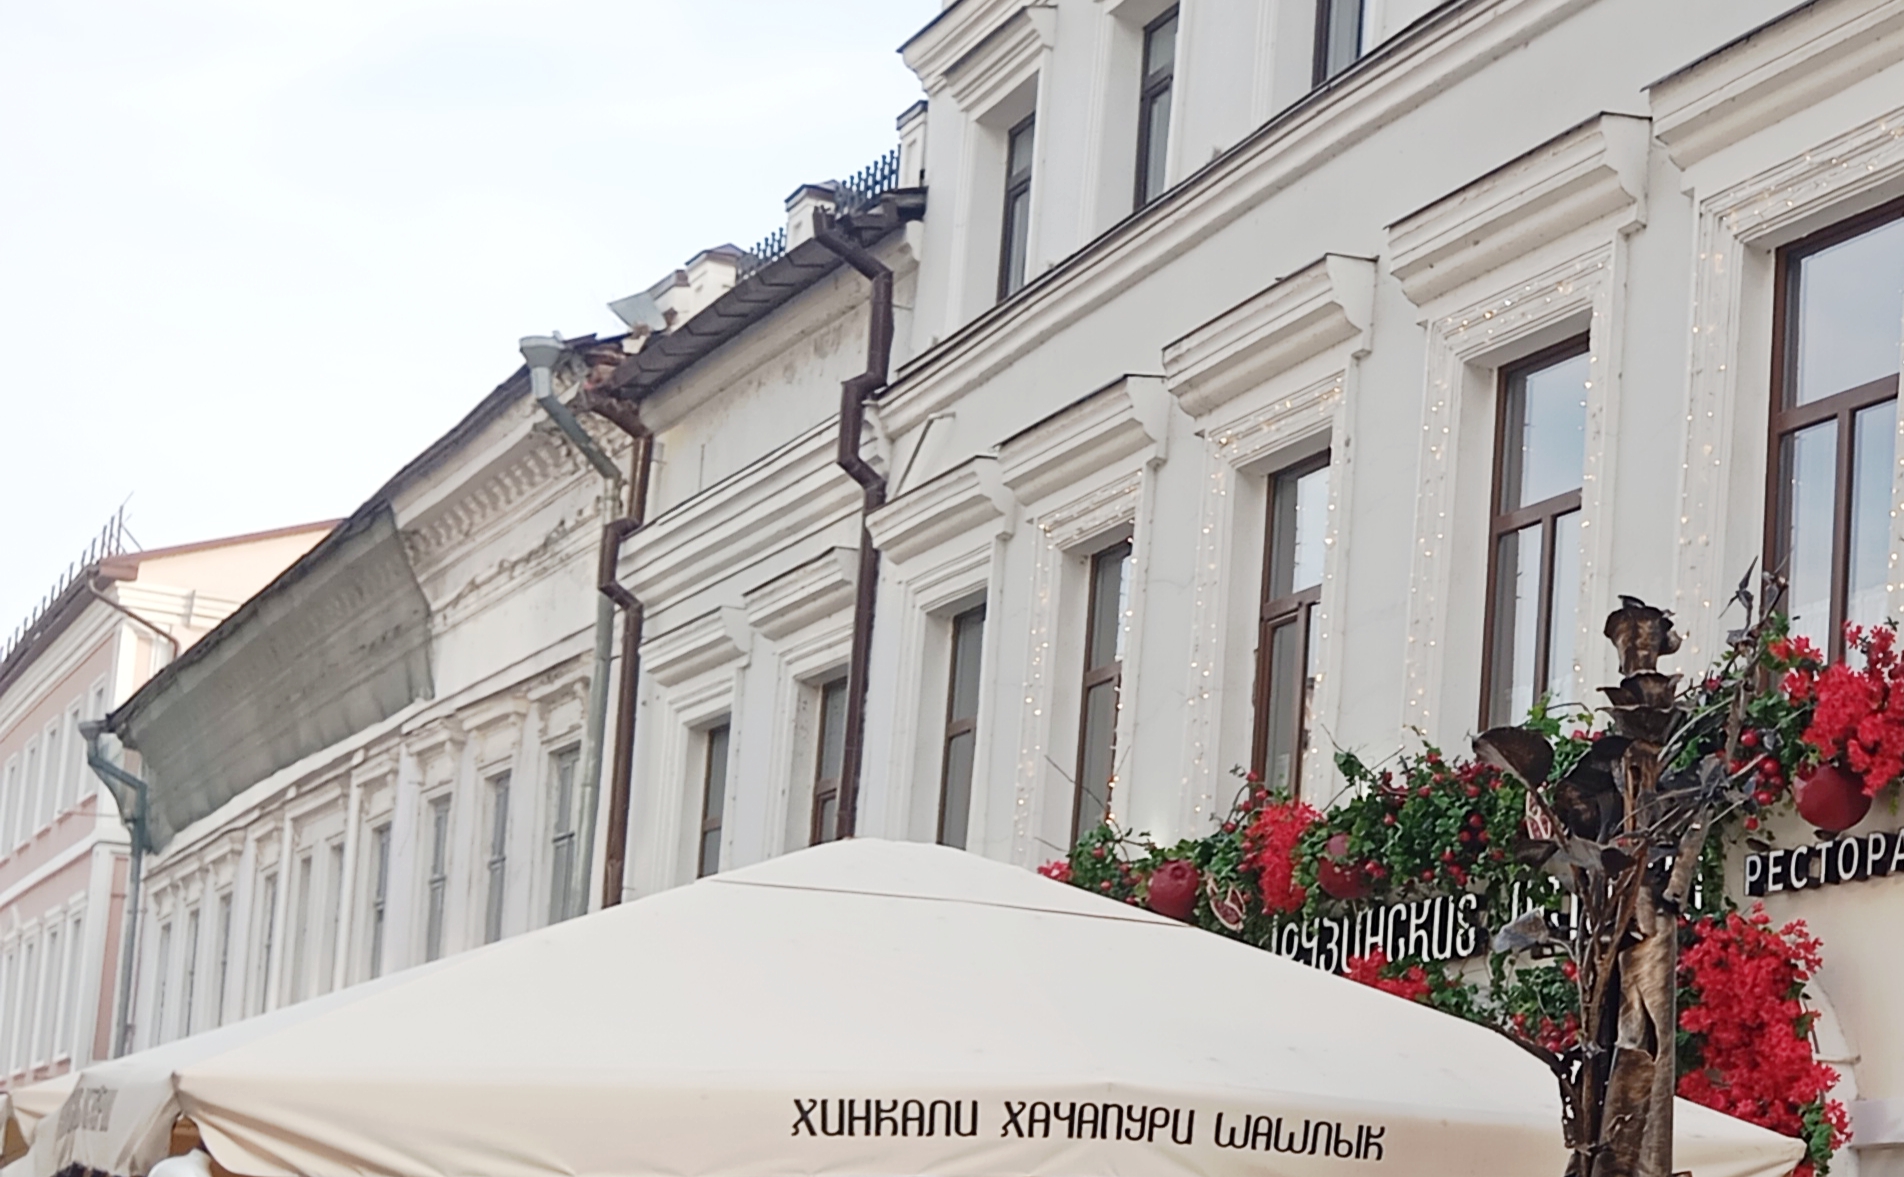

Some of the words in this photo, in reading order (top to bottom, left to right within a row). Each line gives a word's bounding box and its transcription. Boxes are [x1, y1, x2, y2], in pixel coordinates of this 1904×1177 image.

[791, 1099, 978, 1137] ХИНКАЛИ
[1000, 1100, 1195, 1145] ХАЧАПУРИ
[1214, 1112, 1386, 1161] ШАШЛЫК
